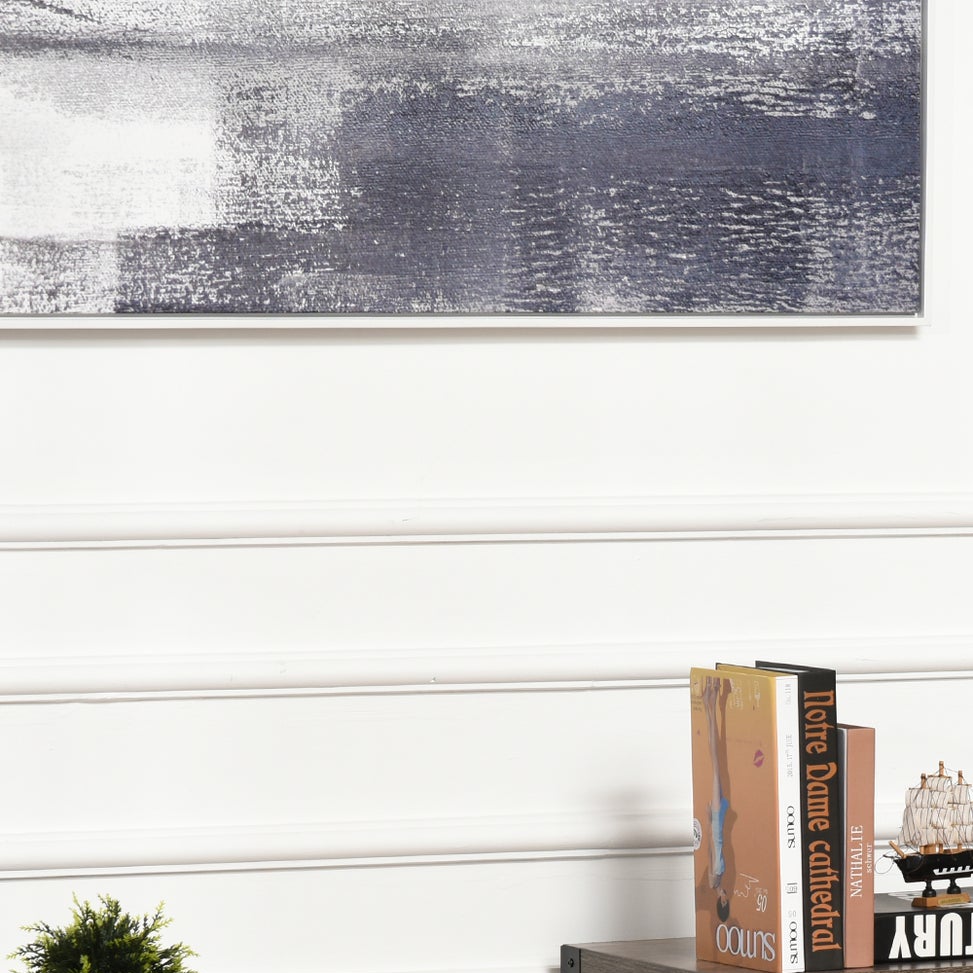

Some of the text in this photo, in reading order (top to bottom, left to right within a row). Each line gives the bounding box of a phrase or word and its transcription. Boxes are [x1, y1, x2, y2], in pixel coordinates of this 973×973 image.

[804, 690, 841, 952] Notre Dame cathedral
[850, 824, 864, 898] NATHALIE
